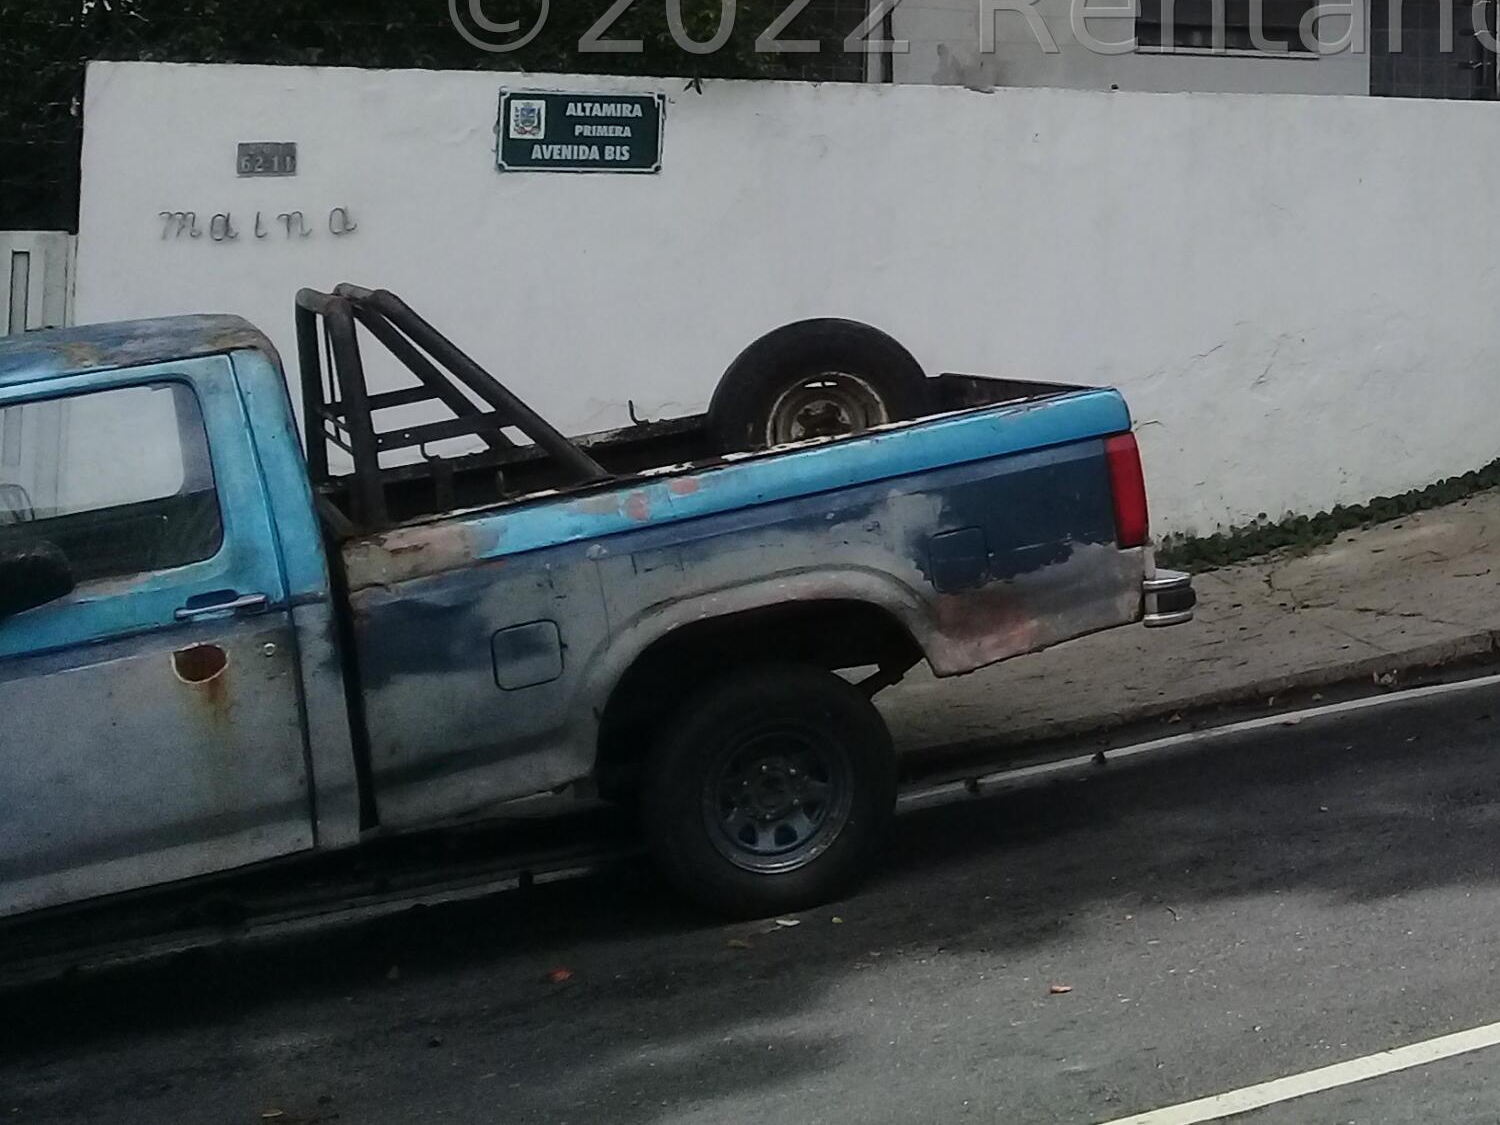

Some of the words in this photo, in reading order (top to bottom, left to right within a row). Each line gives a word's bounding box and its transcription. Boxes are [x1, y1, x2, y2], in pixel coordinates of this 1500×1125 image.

[565, 102, 643, 117] ALTAMIRA
[574, 125, 632, 138] PRIMERA
[531, 144, 599, 160] AVENIDA
[604, 146, 630, 161] BIS
